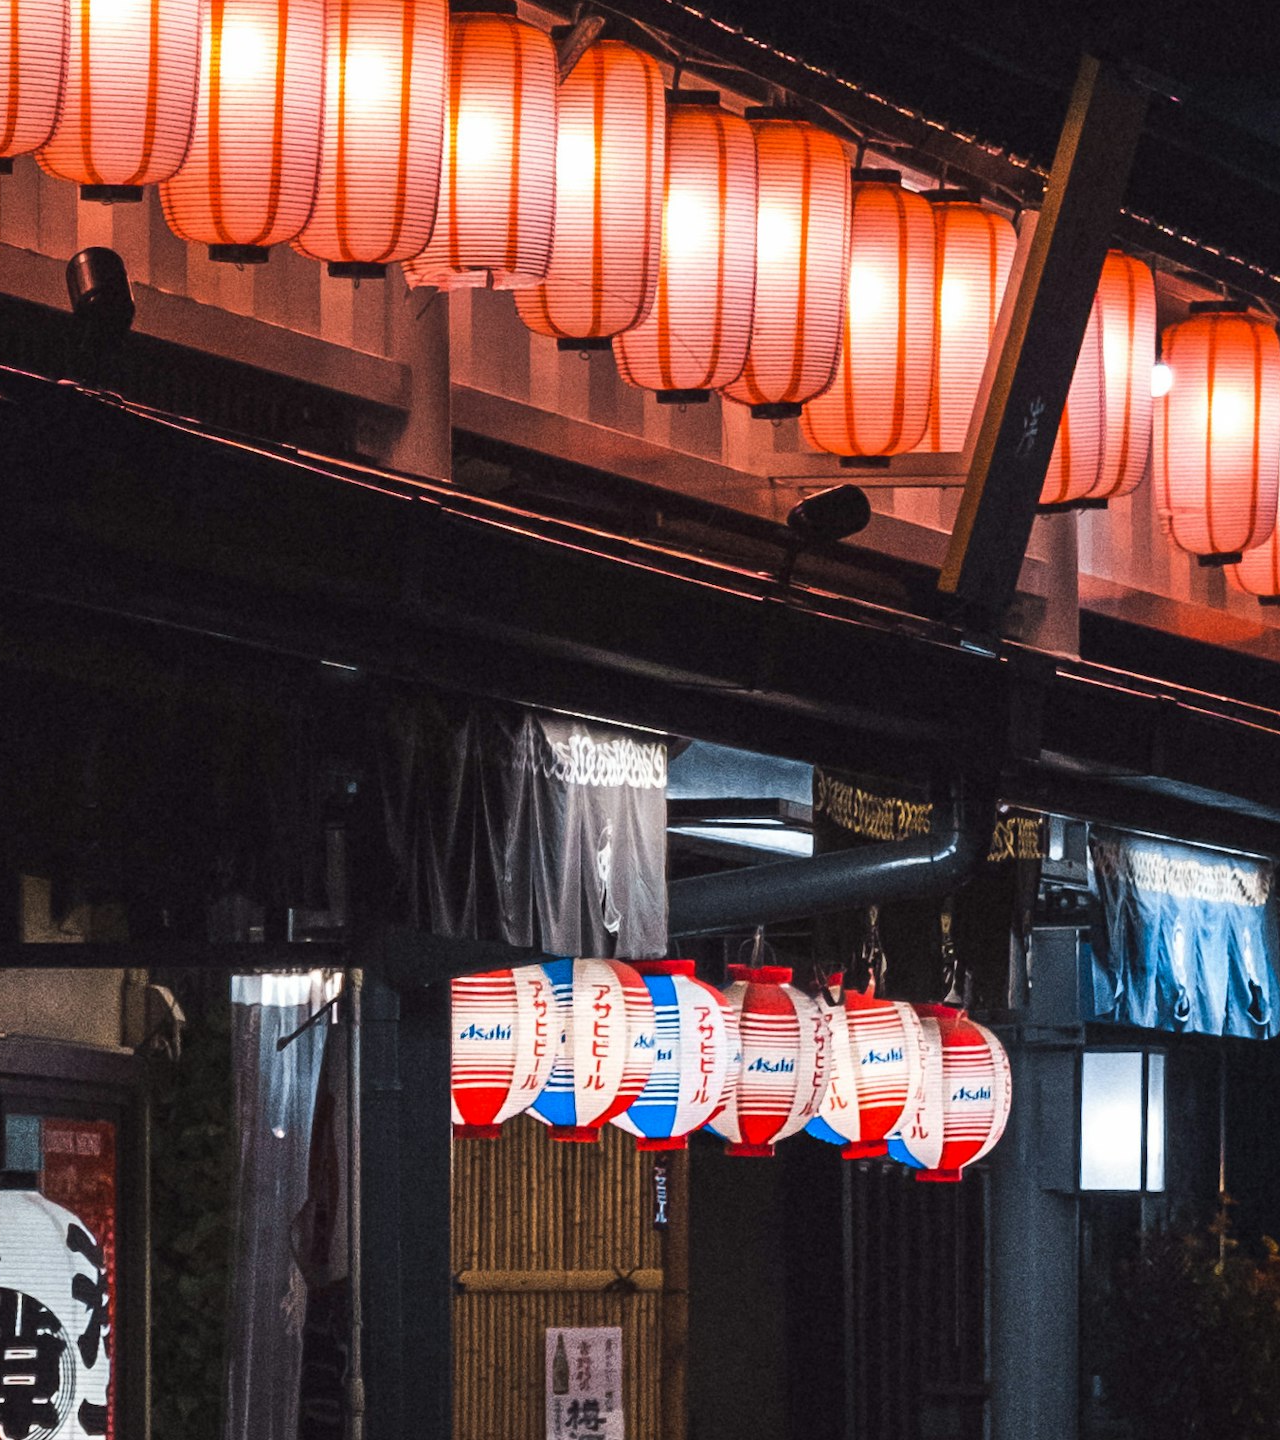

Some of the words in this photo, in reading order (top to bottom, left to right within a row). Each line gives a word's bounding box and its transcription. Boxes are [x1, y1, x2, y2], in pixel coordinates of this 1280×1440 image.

[460, 1023, 512, 1041] Asahi
[521, 981, 549, 1090] アサヒビール
[583, 984, 612, 1091] アサヒビール
[688, 1007, 716, 1104] アサヒビール
[861, 1047, 904, 1065] Asahi
[748, 1057, 794, 1074] Asahi
[798, 1017, 825, 1117] アサヒビール
[952, 1085, 992, 1101] Asahi
